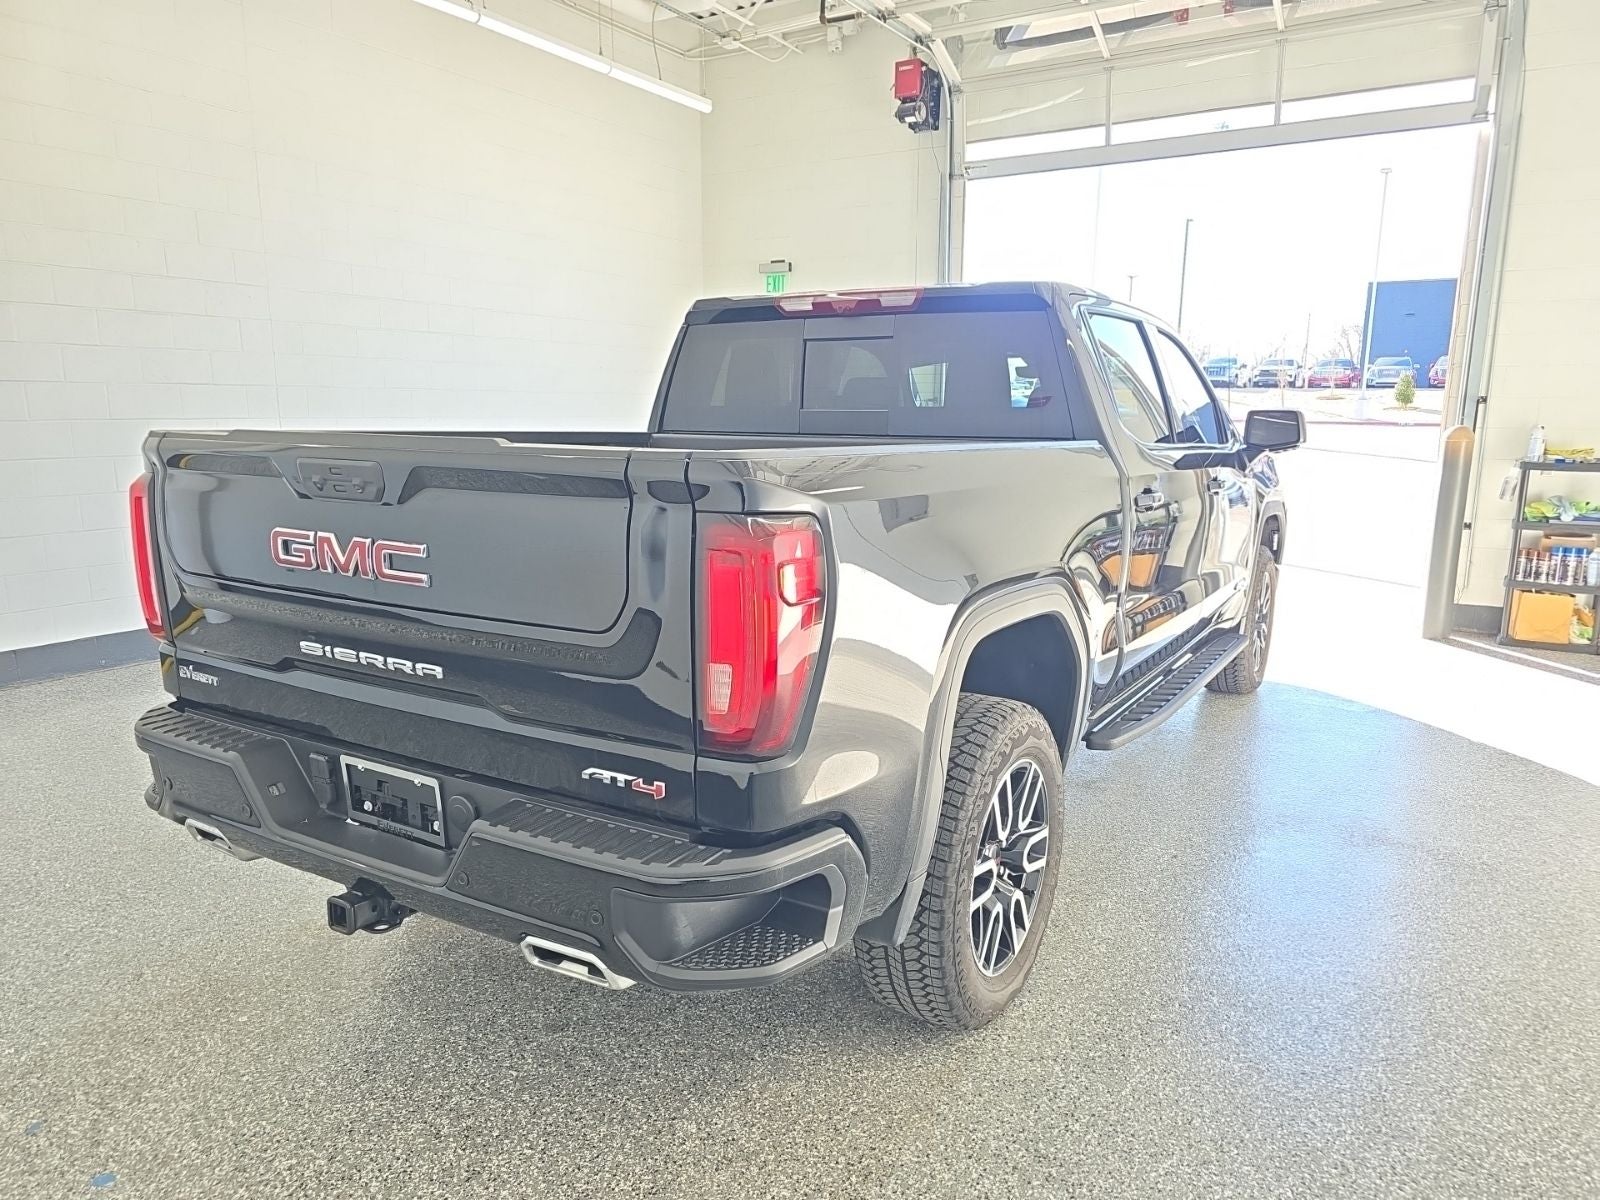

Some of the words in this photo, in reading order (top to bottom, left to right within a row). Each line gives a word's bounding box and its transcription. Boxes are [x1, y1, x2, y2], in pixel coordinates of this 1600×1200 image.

[767, 275, 785, 292] EXIT
[270, 526, 431, 588] GMC
[300, 640, 444, 680] SIERRA
[581, 767, 666, 800] AT4
